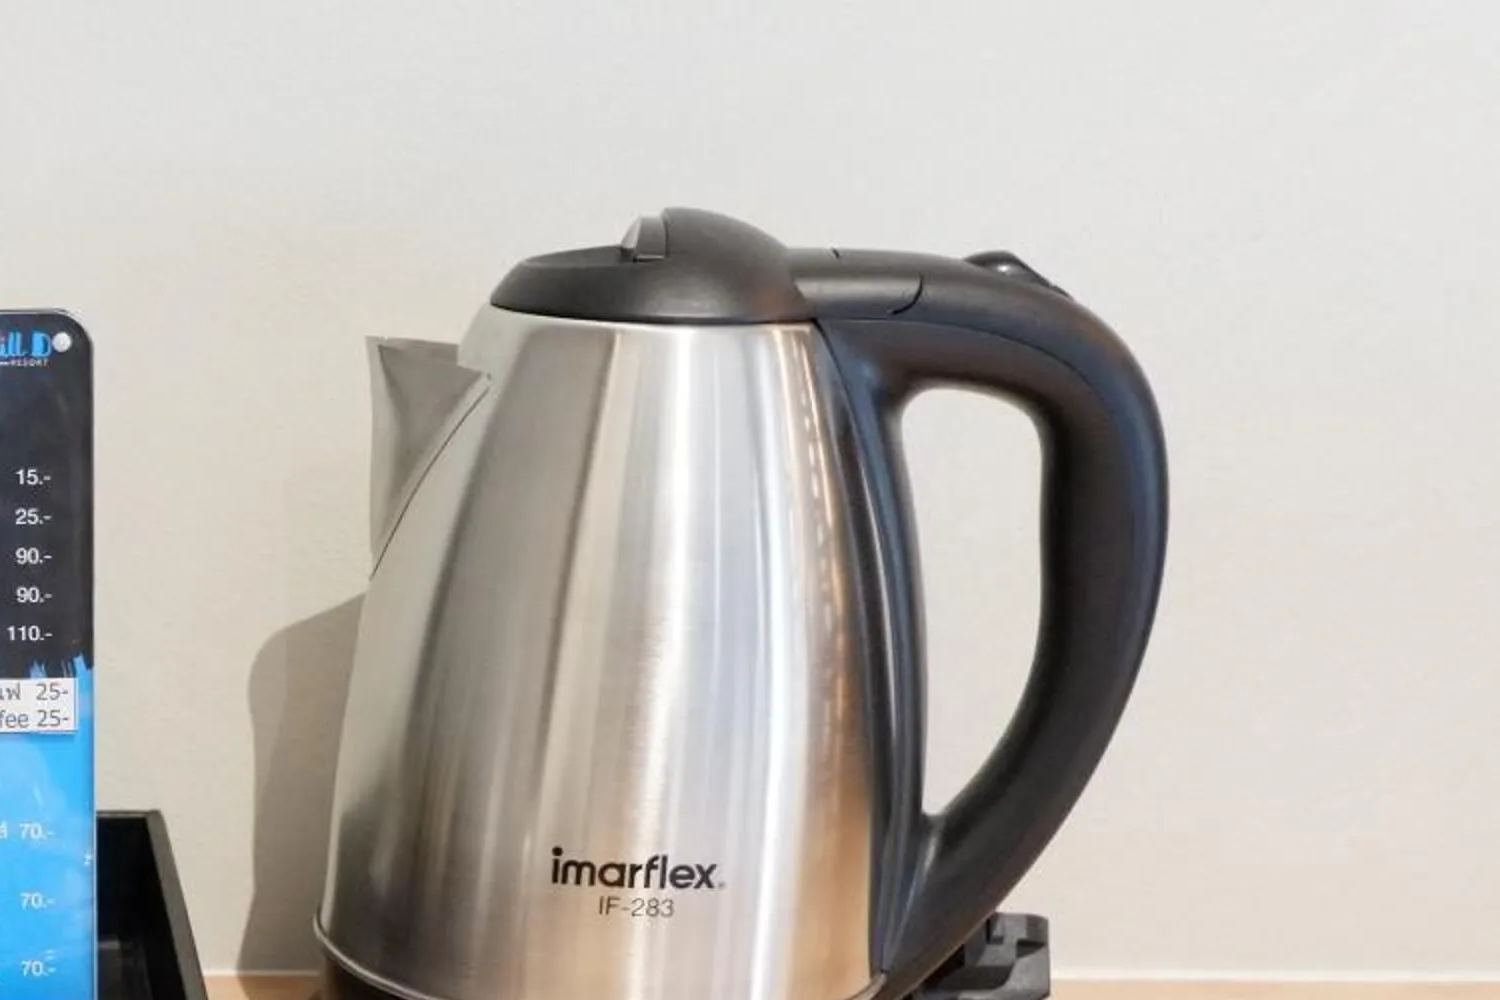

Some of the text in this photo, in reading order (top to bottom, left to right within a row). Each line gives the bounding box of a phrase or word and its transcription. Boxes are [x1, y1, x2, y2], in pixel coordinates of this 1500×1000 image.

[32, 331, 52, 357] D
[552, 846, 717, 889] imarflex
[598, 895, 675, 917] IF-283
